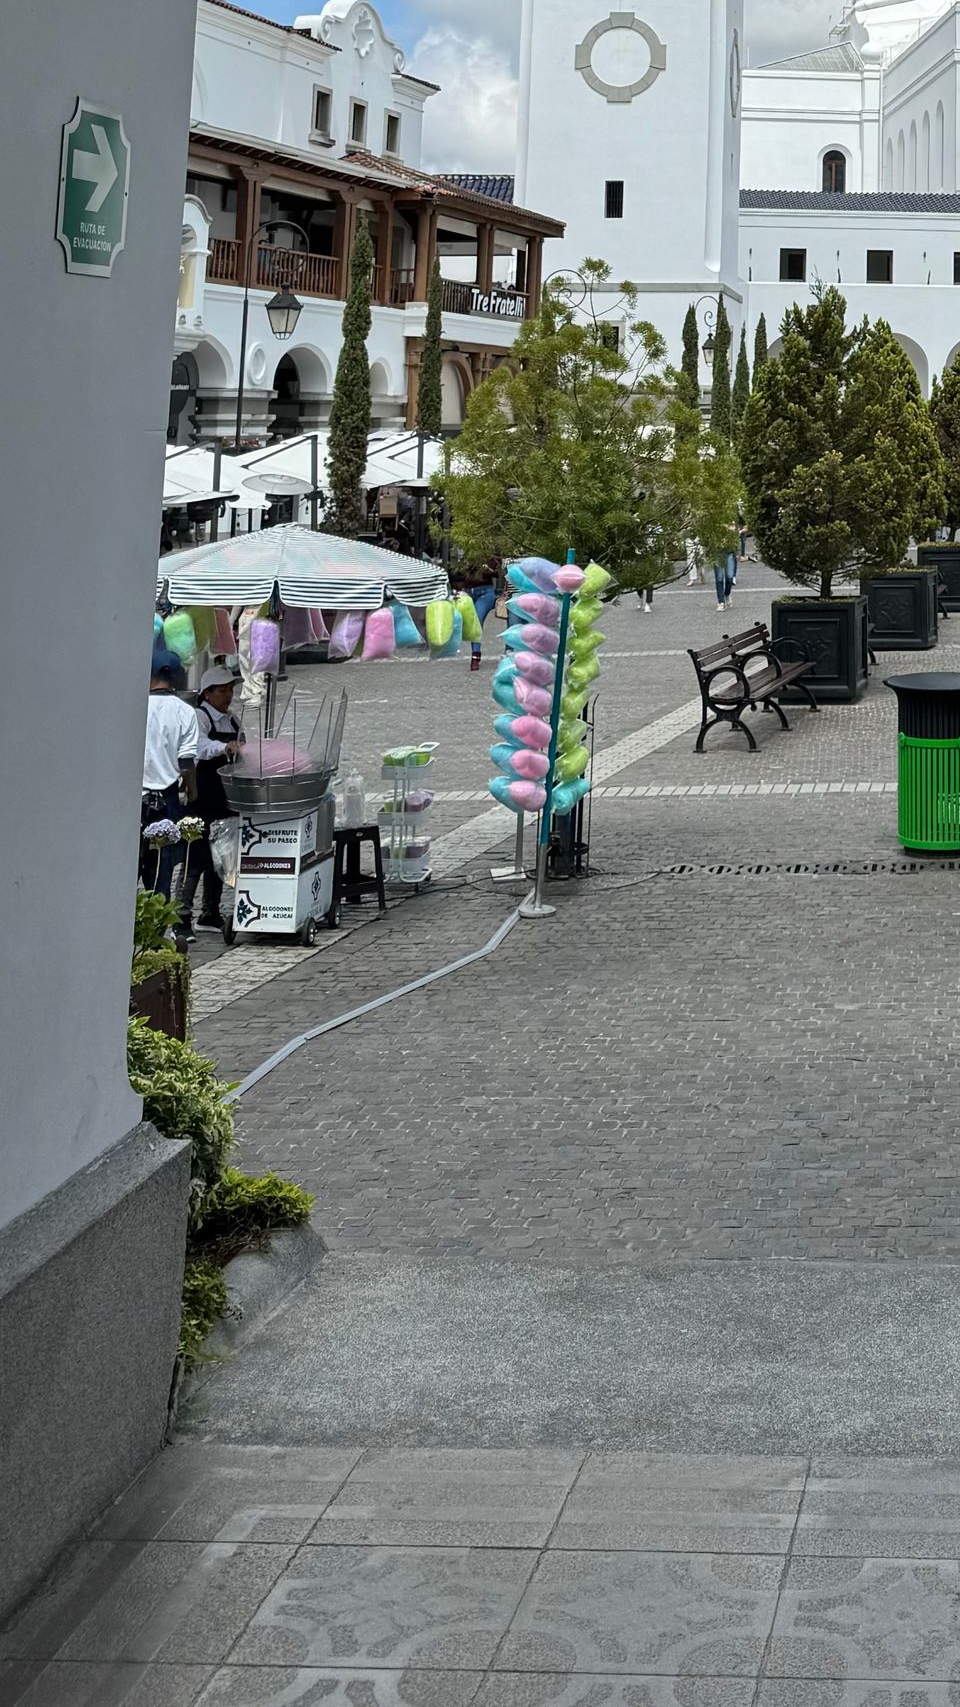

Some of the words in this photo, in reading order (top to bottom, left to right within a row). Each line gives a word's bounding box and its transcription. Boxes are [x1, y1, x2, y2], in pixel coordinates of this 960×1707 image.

[80, 221, 97, 235] RUTA
[97, 225, 106, 236] DE
[471, 288, 489, 312] Tre
[490, 291, 523, 317] Fratelli
